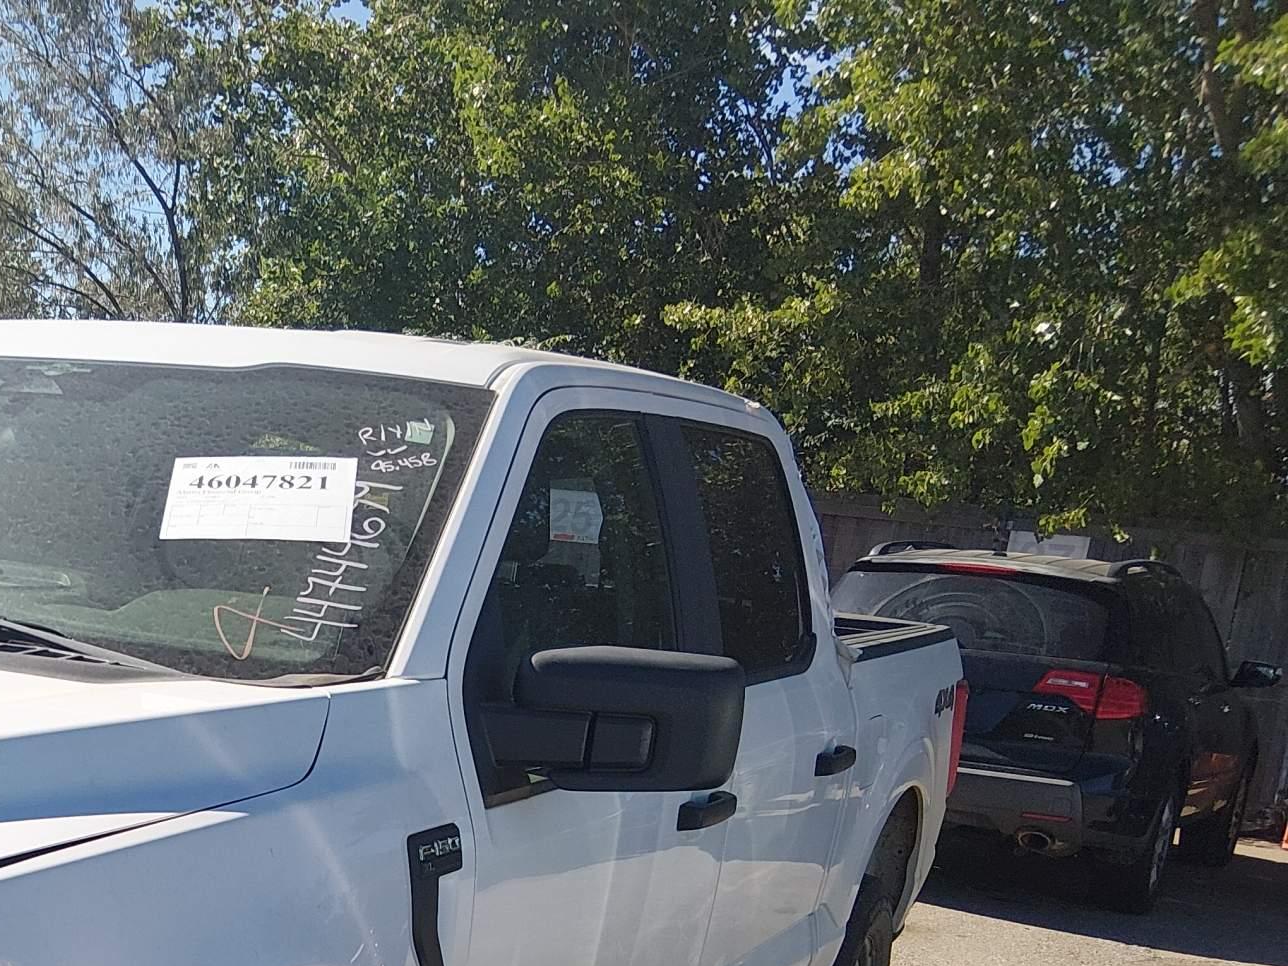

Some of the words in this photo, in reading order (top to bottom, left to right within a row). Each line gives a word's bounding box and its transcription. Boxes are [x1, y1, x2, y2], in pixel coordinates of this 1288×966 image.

[189, 474, 329, 490] 46047821
[1026, 703, 1070, 714] MDX
[418, 836, 460, 861] F-150
